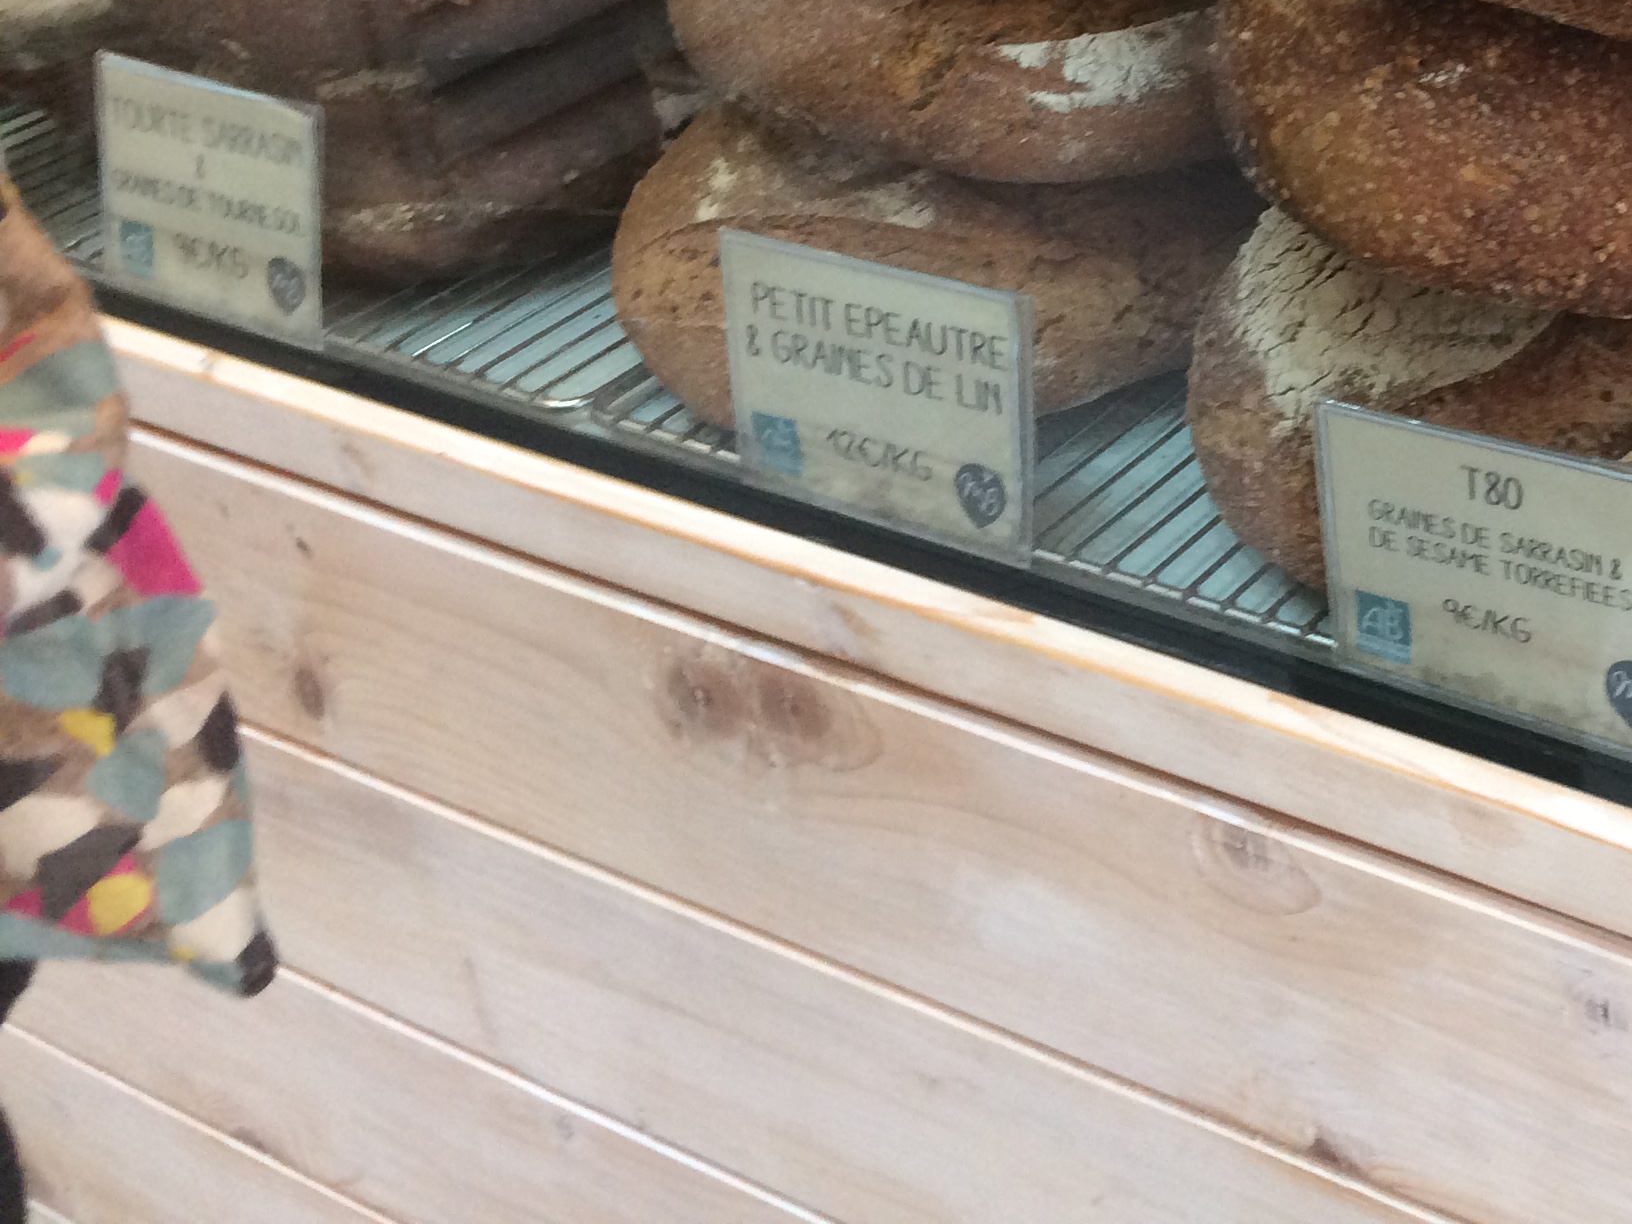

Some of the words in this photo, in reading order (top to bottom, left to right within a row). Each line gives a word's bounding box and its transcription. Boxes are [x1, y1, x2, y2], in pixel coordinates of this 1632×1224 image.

[751, 280, 834, 331] PETIT
[844, 302, 1008, 372] EPEAUTRE
[745, 324, 761, 357] &
[771, 329, 894, 388] GRAINES
[903, 360, 943, 401] DE
[956, 373, 1003, 416] LIN
[1461, 464, 1525, 511] T80
[1367, 525, 1400, 553] DE
[1367, 498, 1456, 540] GRAINES
[1460, 522, 1492, 550] DE
[1499, 531, 1604, 576] SARRASIN
[1608, 556, 1623, 581] &
[1441, 597, 1534, 644] 9€/KG
